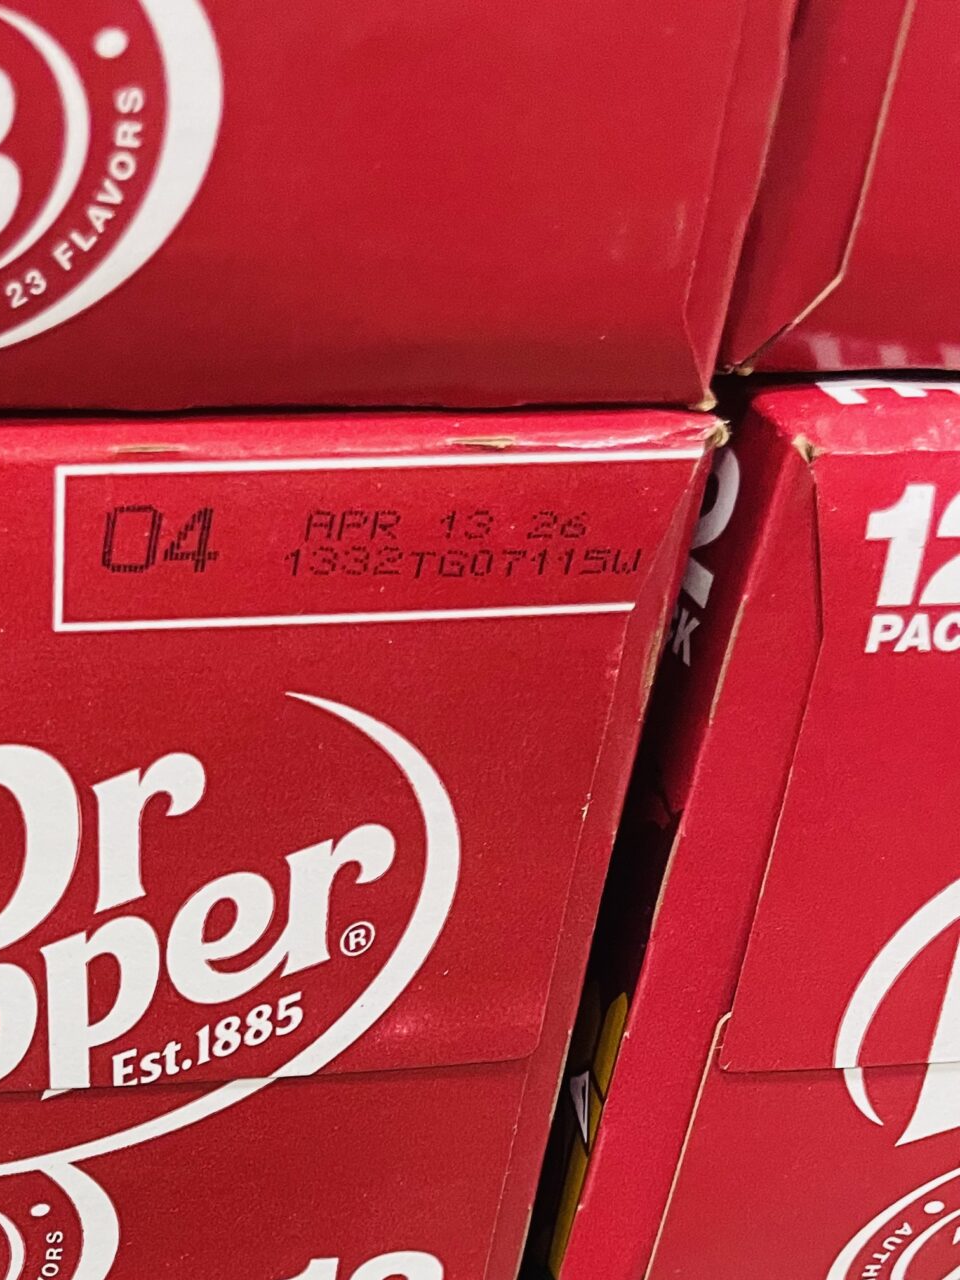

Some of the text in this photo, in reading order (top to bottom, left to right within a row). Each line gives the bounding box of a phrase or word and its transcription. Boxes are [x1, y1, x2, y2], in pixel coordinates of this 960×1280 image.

[5, 271, 48, 309] 23
[53, 85, 146, 272] FLAVORS
[102, 504, 220, 573] 04
[305, 510, 586, 542] APR 13 26
